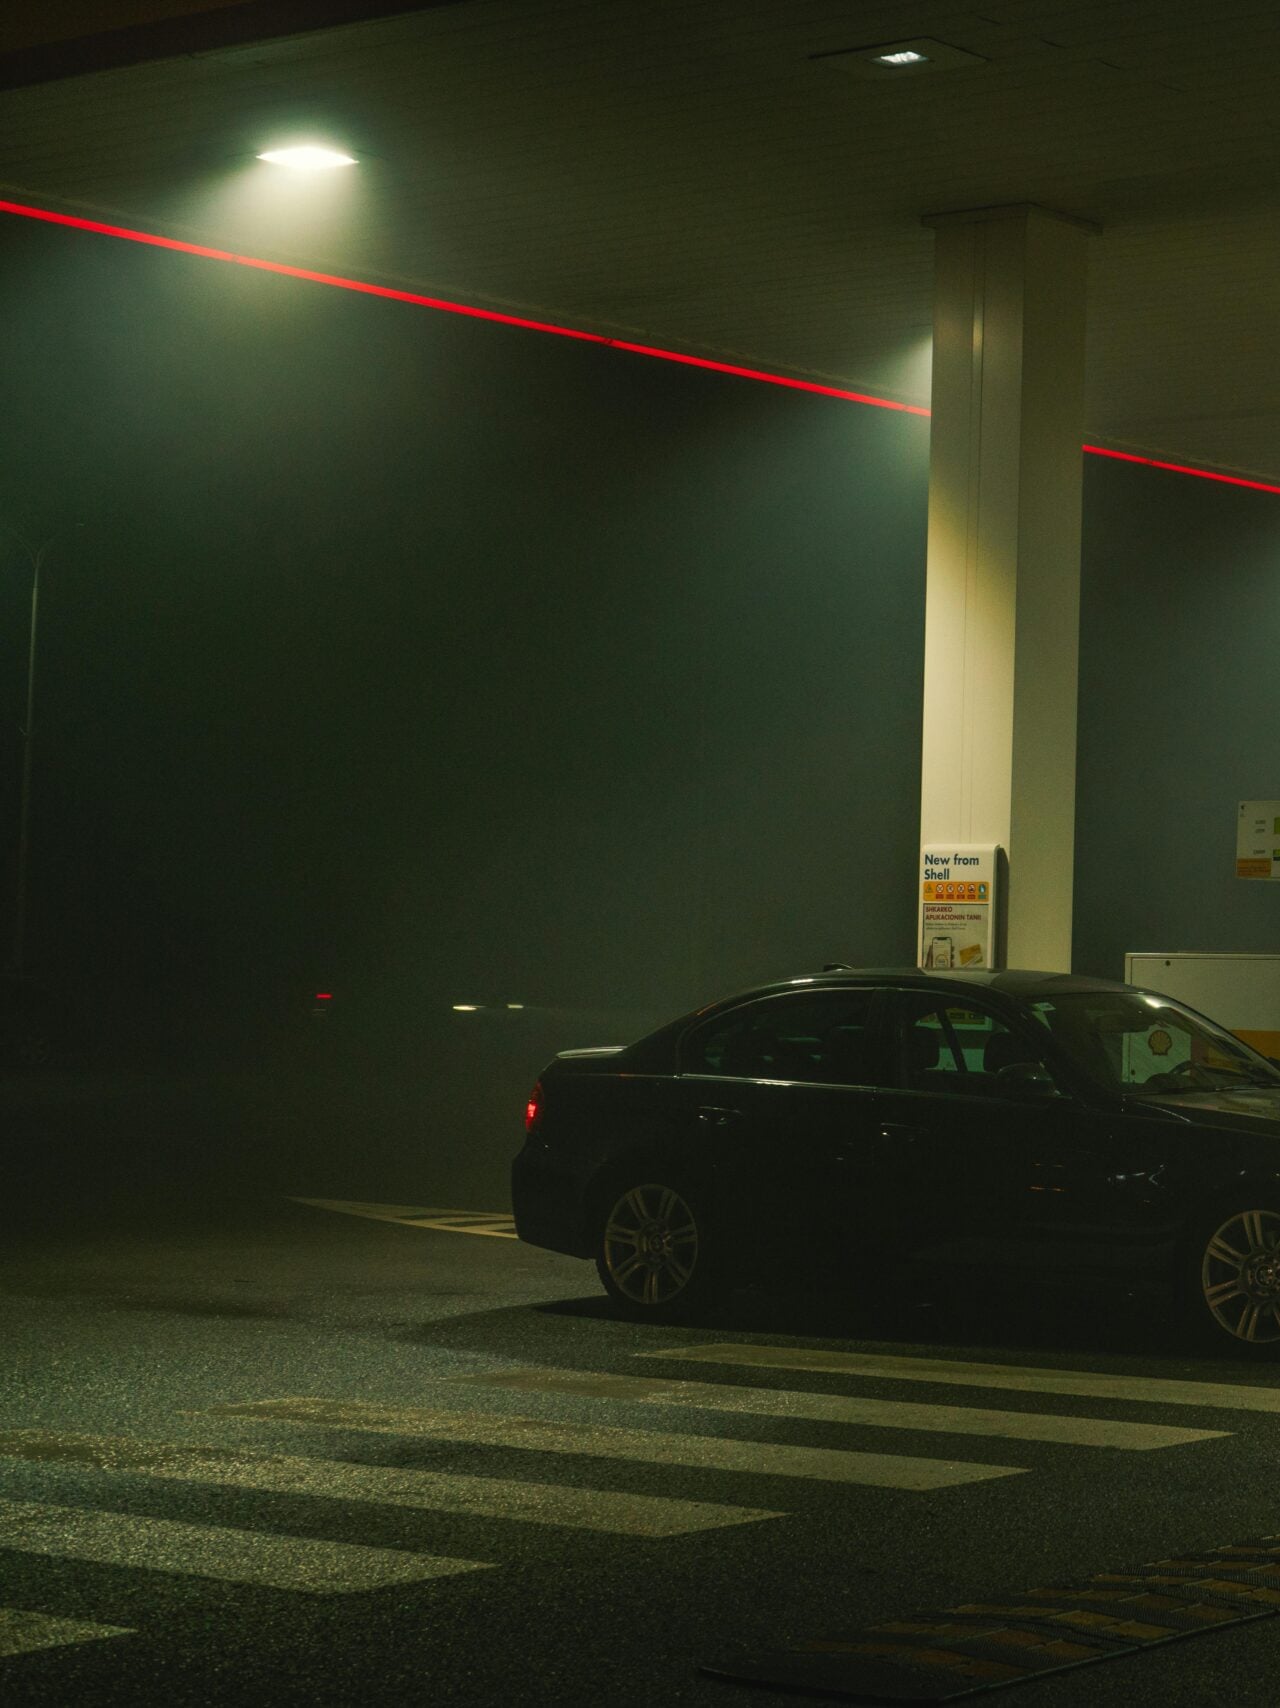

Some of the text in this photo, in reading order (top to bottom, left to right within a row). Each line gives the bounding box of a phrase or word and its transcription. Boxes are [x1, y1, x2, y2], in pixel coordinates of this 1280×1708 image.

[924, 854, 980, 866] New from
[924, 868, 950, 880] Shell
